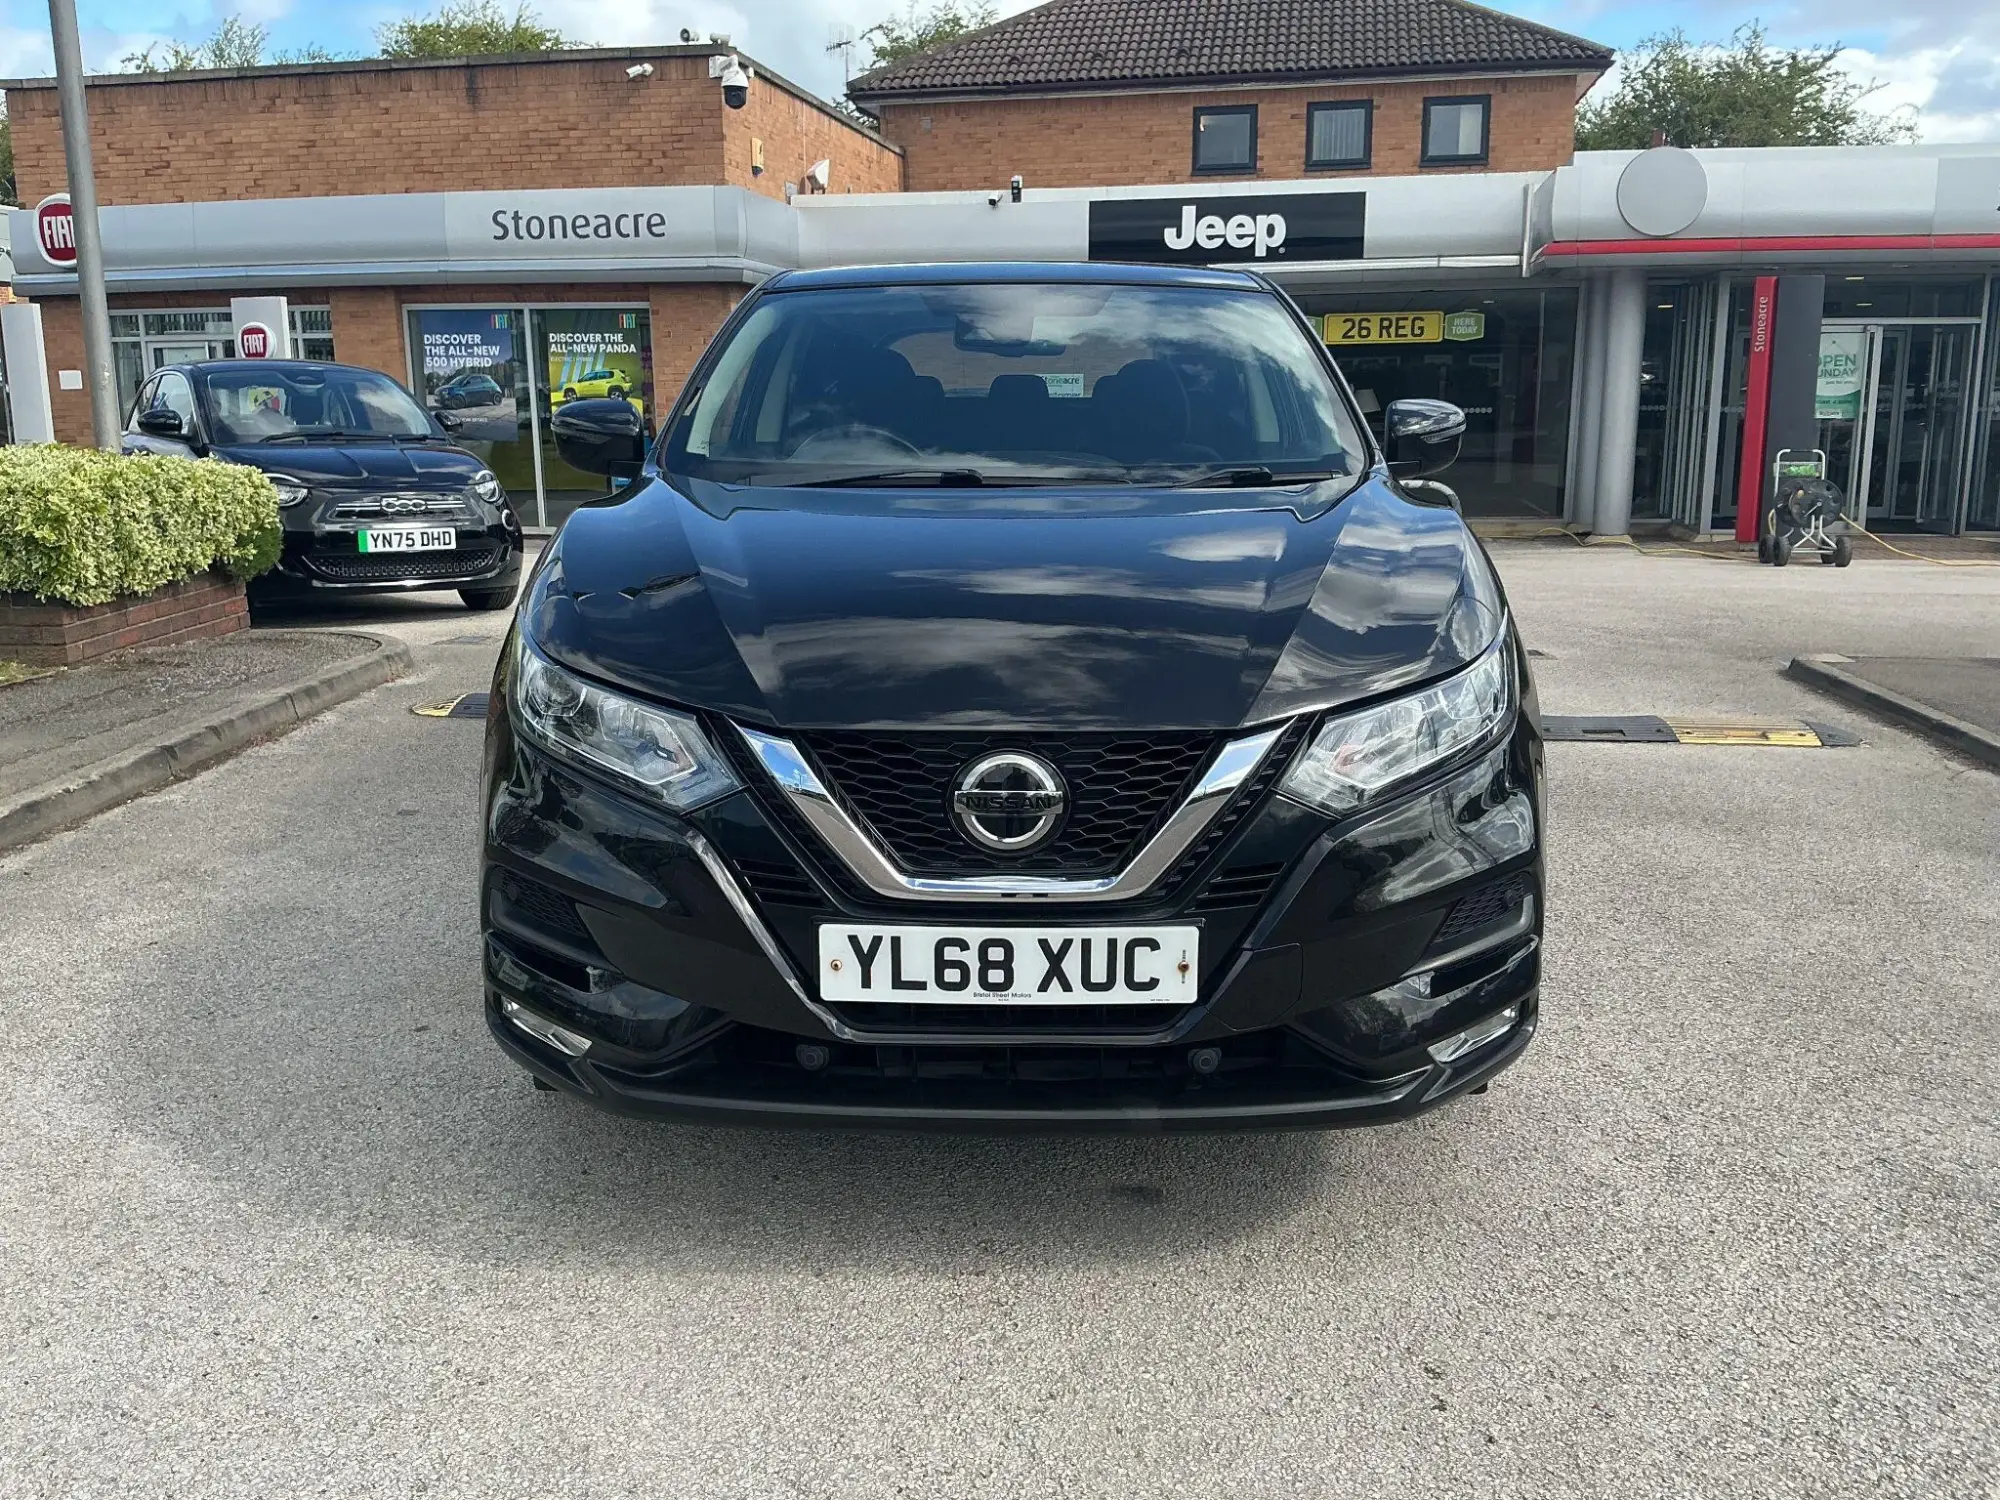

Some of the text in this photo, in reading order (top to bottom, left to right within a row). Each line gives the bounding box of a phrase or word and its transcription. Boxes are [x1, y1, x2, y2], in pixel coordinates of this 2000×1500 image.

[491, 209, 666, 241] Stoneacre
[1163, 205, 1287, 257] Jeep
[619, 313, 637, 329] FIAT
[1341, 317, 1372, 340] 26
[1378, 316, 1426, 339] REG
[1453, 317, 1476, 326] HERE
[1753, 296, 1769, 352] Stoneacre
[1451, 325, 1478, 335] TODAY
[243, 333, 265, 354] FIAT
[423, 333, 482, 345] DISCOVER
[549, 333, 624, 343] DISCOVER THE
[424, 345, 501, 356] THE ALL-NEW
[550, 343, 637, 353] ALL-NEW PANDA
[426, 357, 492, 368] 500 HYBRID
[1817, 367, 1857, 378] UNDAY
[381, 498, 427, 512] 500
[370, 531, 452, 549] YN75 DHD
[966, 794, 1053, 811] NISSAN
[847, 934, 1015, 992] YL68
[1036, 937, 1162, 993] XUC
